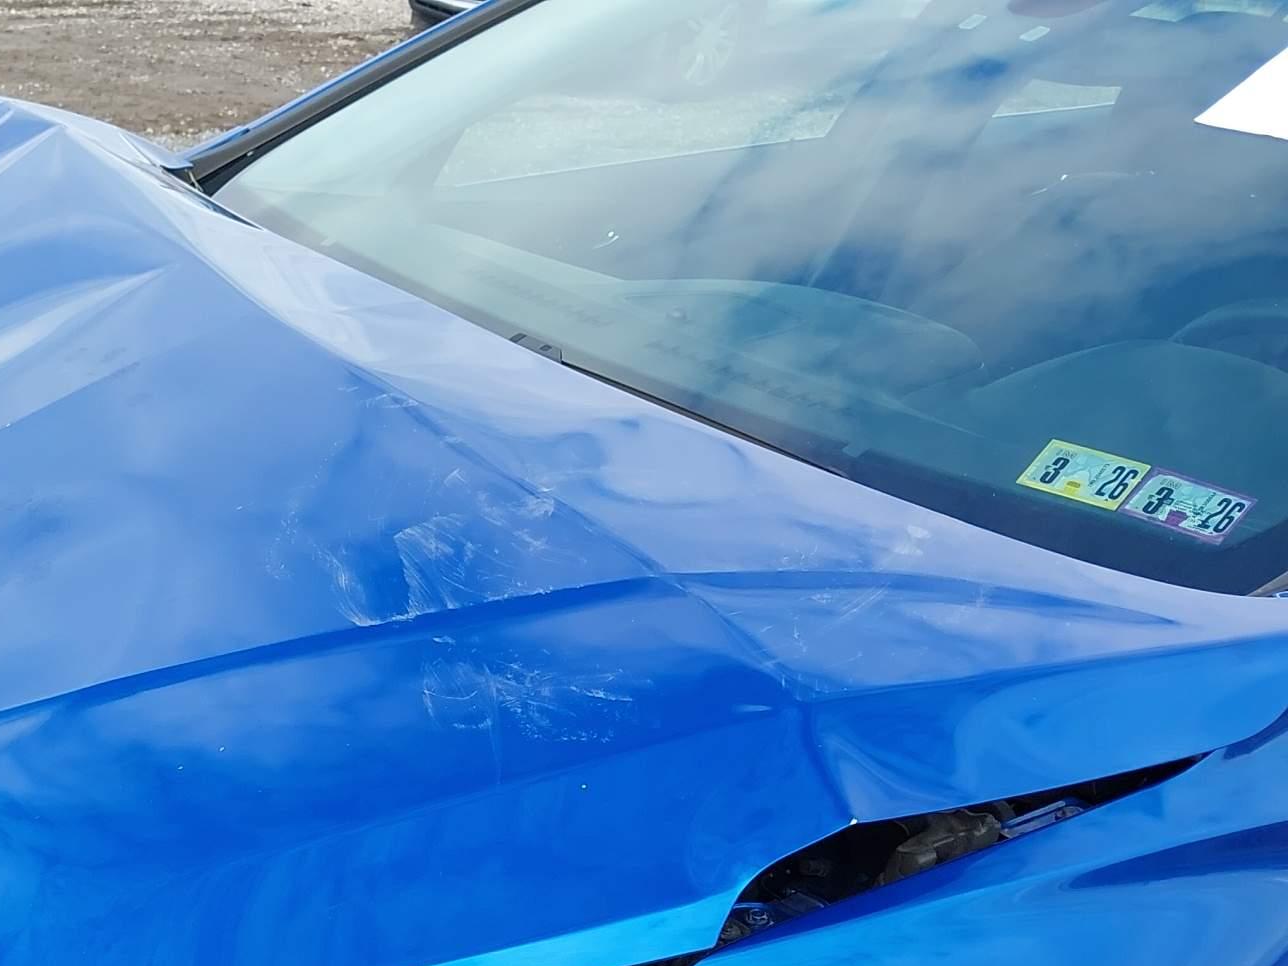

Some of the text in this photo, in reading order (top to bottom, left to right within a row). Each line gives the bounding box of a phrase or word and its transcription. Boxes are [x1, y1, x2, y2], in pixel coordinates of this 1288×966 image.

[1040, 457, 1070, 484] 3
[1095, 465, 1140, 500] 26
[1143, 487, 1174, 514] 3
[1199, 497, 1246, 533] 26
